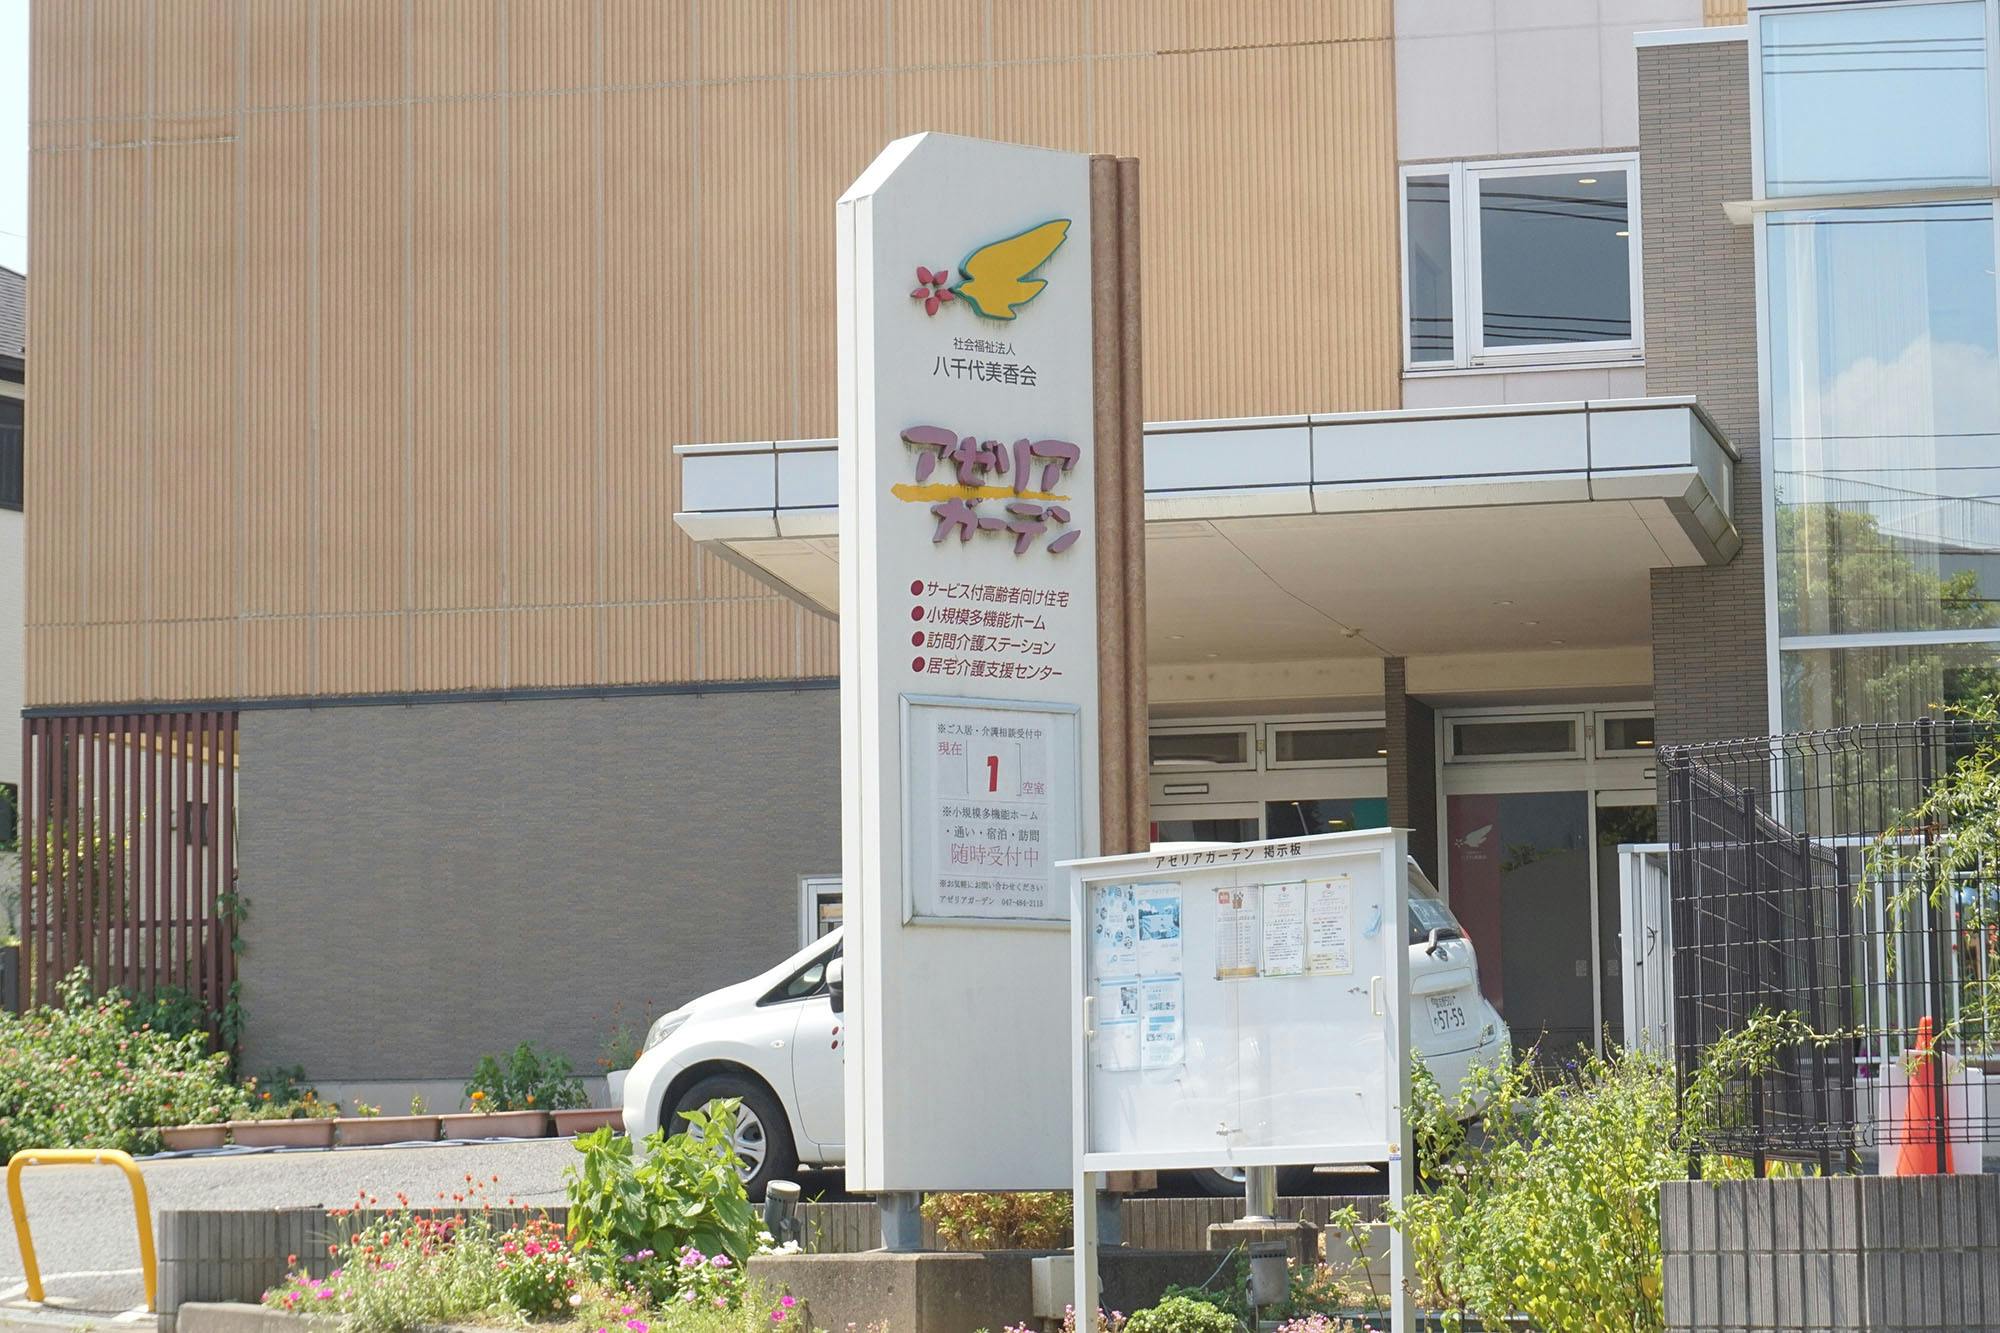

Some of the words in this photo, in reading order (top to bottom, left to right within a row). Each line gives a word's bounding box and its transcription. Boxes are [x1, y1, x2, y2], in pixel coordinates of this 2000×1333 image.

[953, 337, 1016, 356] 社会福祉法人
[933, 356, 1037, 386] 八千代美香会
[931, 497, 1082, 554] ガーデン
[927, 581, 1070, 607] サービス付高齢者向け住宅
[926, 606, 1046, 630] 小規模多機能ホーム
[926, 631, 1056, 655] 訪問介護ステーション
[926, 656, 1063, 681] 居宅介護支援センター
[937, 741, 962, 756] 現在
[987, 755, 999, 792] 1
[1022, 781, 1045, 795] 空室
[951, 843, 1039, 868] 随時受付中
[1155, 848, 1254, 869] アゼリアガーデン
[1264, 842, 1301, 859] 掲示板
